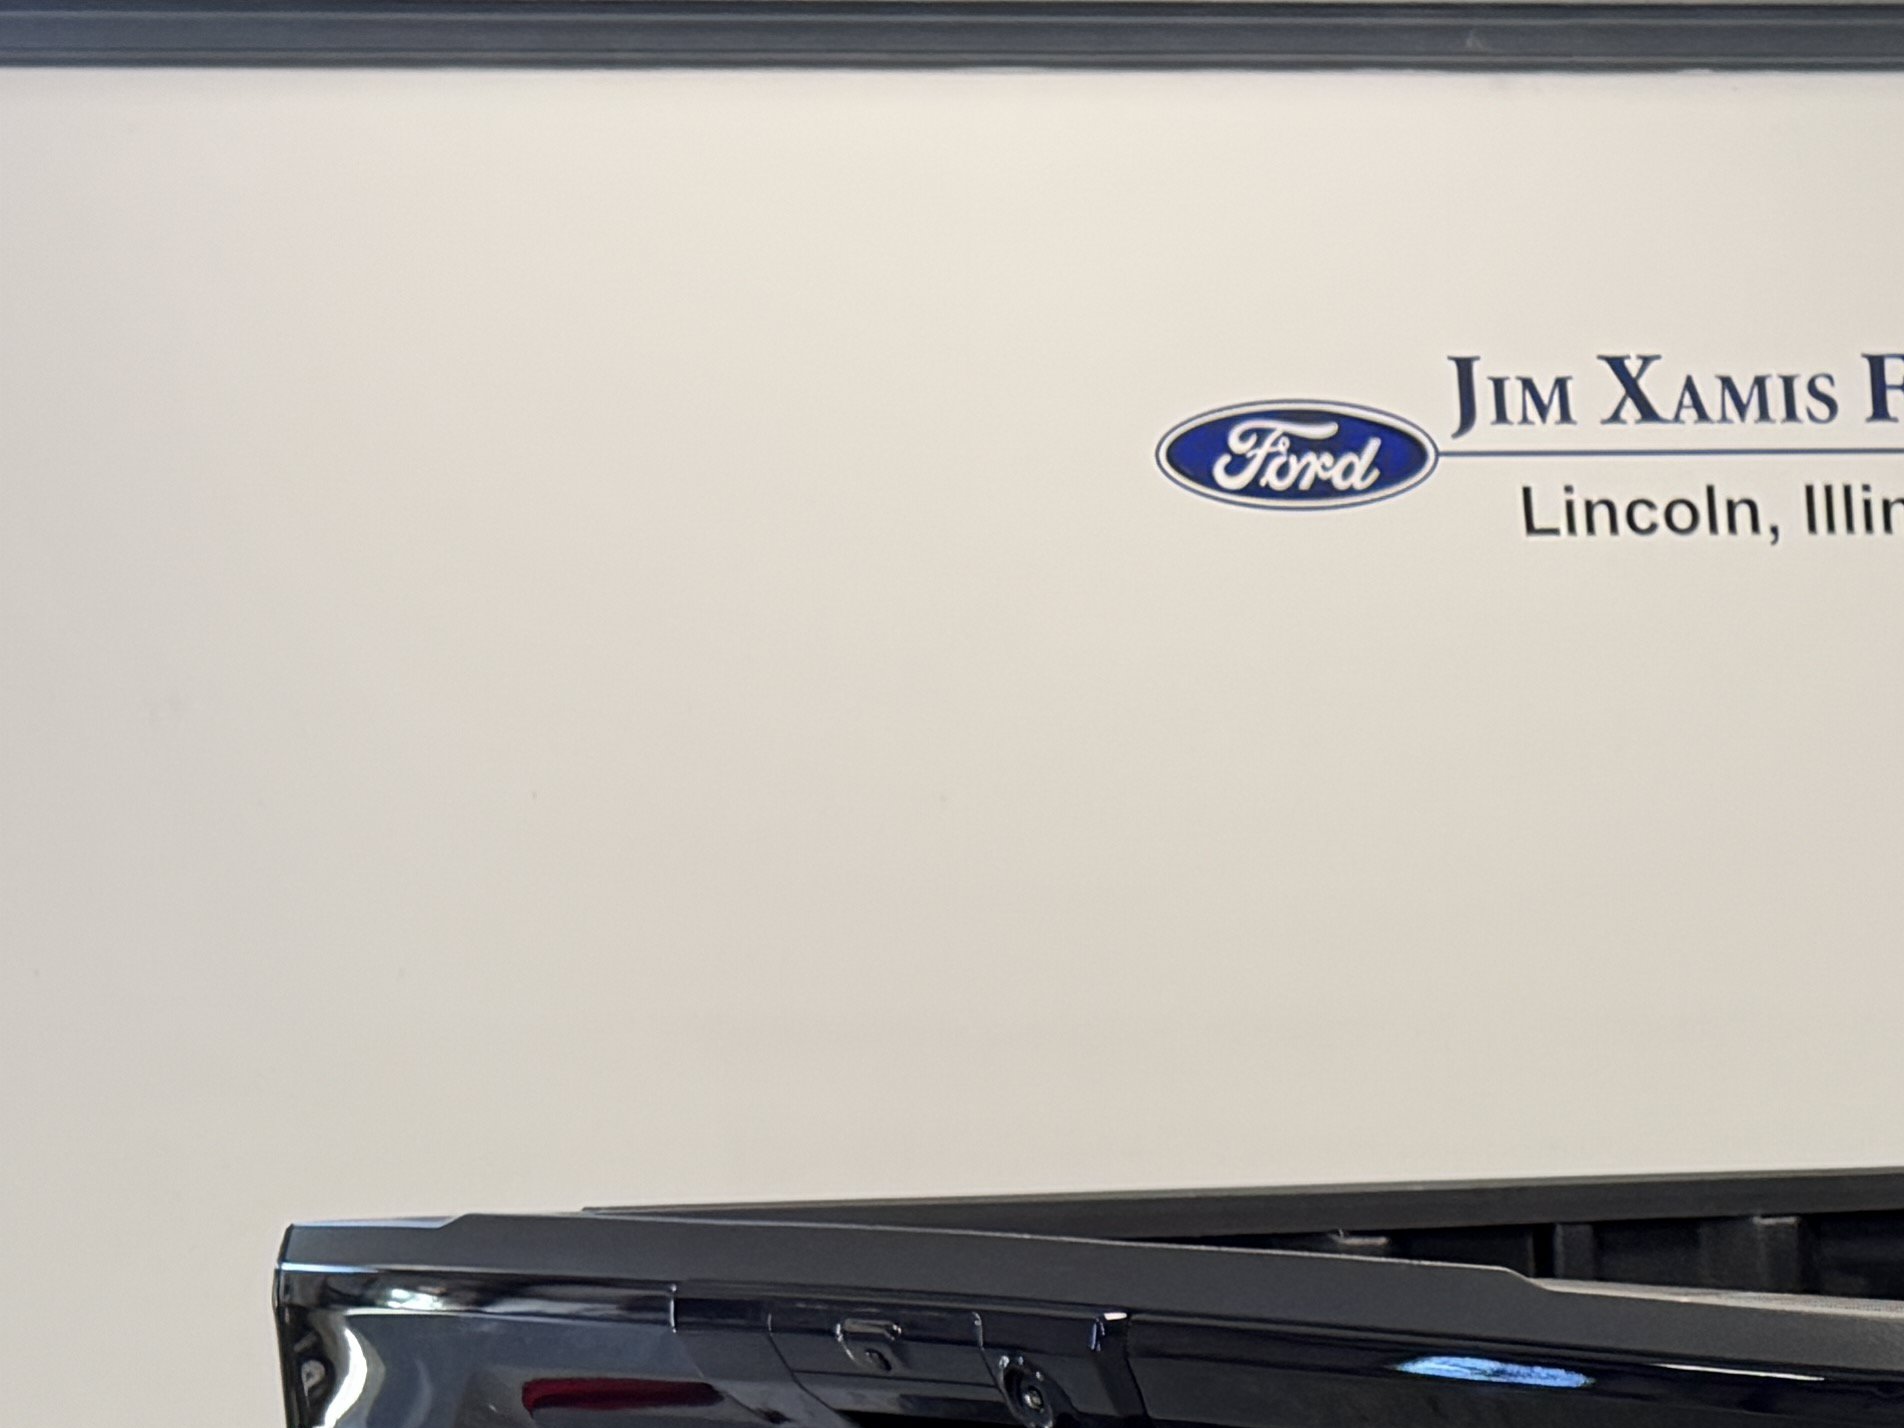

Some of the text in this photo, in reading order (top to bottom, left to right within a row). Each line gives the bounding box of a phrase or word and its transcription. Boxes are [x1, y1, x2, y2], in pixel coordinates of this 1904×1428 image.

[1446, 355, 1577, 440] JIM
[1596, 353, 1840, 427] XAMIS
[1210, 418, 1382, 493] Ford
[1521, 484, 1780, 546] Lincoln,
